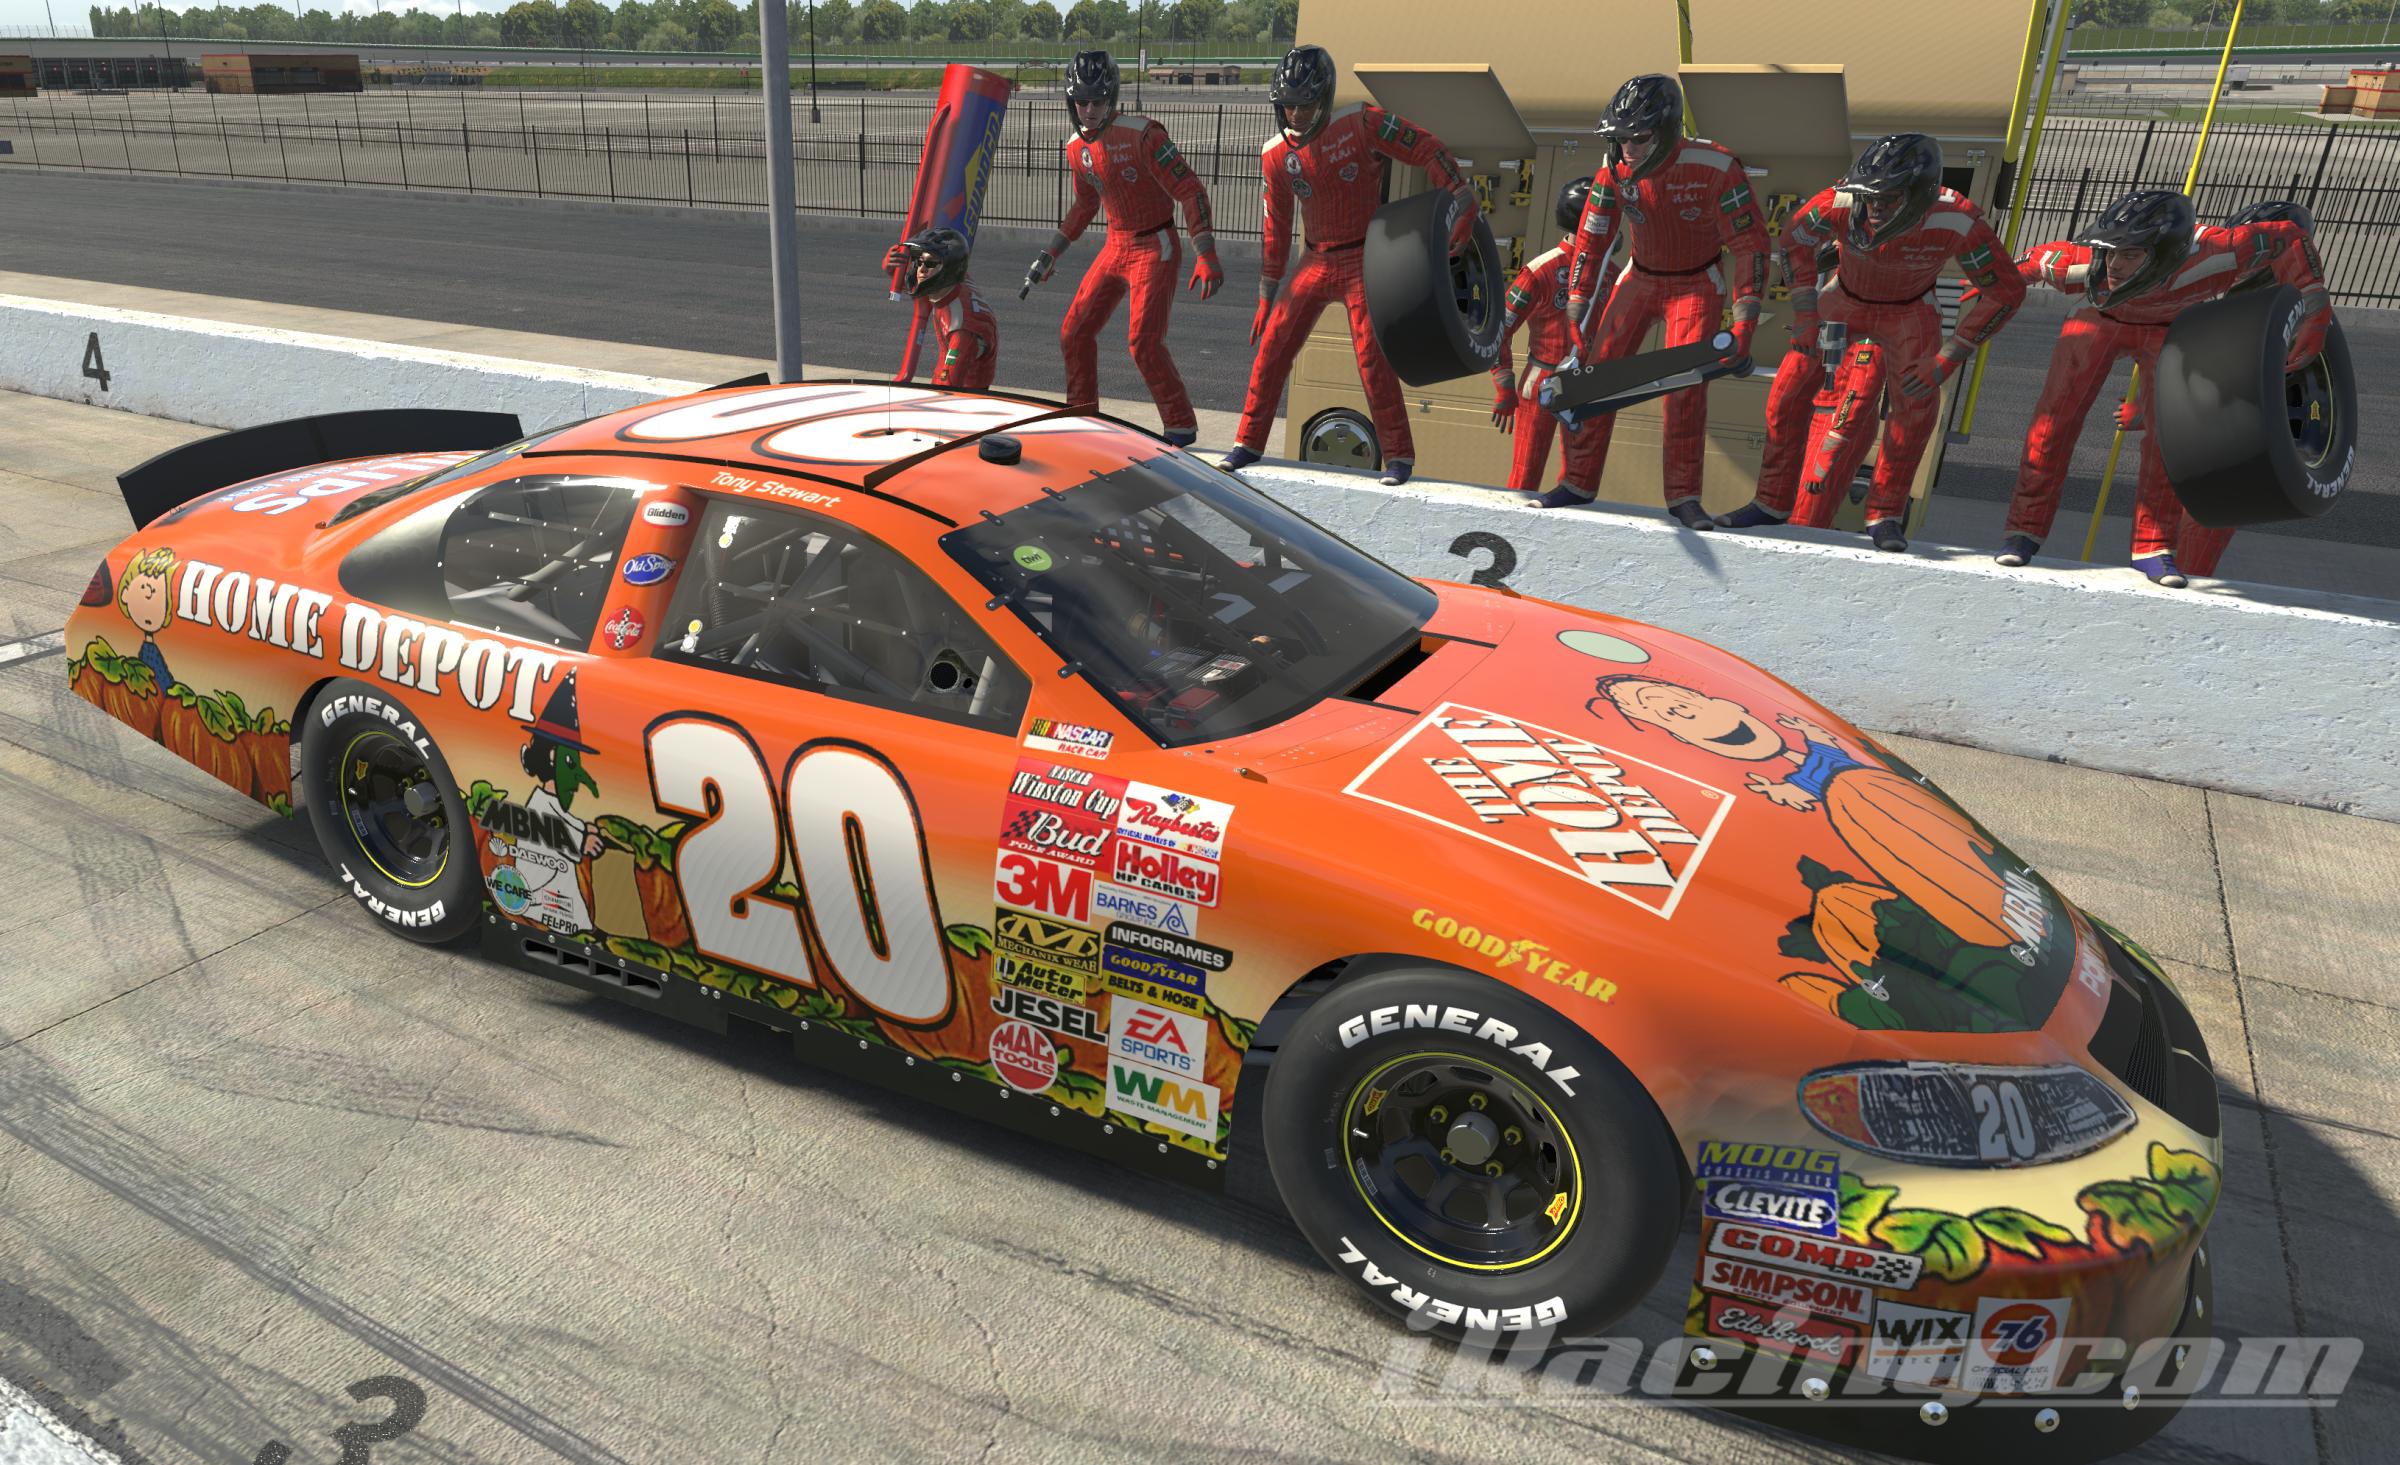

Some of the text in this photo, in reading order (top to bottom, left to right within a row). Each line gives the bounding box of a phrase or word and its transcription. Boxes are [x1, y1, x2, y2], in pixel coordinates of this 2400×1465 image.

[964, 111, 999, 237] SUNOCO
[81, 331, 111, 391] 4
[710, 471, 841, 508] Tony Stewart
[647, 507, 686, 521] Glidden
[623, 555, 677, 575] Old Spice
[176, 560, 561, 723] HOME DEPOT
[321, 695, 429, 759] GENERAL
[1053, 722, 1109, 748] NASCAR
[1058, 743, 1108, 759] RACE CAR
[1009, 771, 1121, 821] Winston Cup
[1047, 765, 1094, 786] NASCAR
[1422, 757, 1530, 825] THE
[1543, 736, 1702, 847] DEPOT
[1125, 796, 1220, 843] Raybestos
[1429, 714, 1679, 889] HOME
[479, 800, 582, 859] MBNA
[1027, 811, 1112, 857] Bud
[509, 845, 569, 873] DAEWOO
[642, 709, 958, 1033] 20
[1008, 840, 1096, 866] POLE AWARD
[1117, 842, 1217, 903] Holley
[341, 862, 447, 928] GENERAL
[486, 877, 533, 901] WE CARE
[996, 853, 1092, 923] 3M
[1096, 892, 1158, 920] BARNES
[1115, 871, 1137, 883] HP
[1141, 878, 1196, 900] CARBS
[997, 935, 1098, 972] MECHANIX WEAR
[1111, 925, 1225, 968] INFOGRAMES
[1411, 907, 1619, 1003] GOODYEAR
[1015, 974, 1084, 1000] Meter
[1020, 961, 1074, 986] Auto
[1110, 953, 1199, 986] GOODYEAR
[1108, 975, 1199, 1011] BELTS & HOSE
[992, 989, 1107, 1044] JESEL
[1124, 1008, 1189, 1055] EA
[993, 1023, 1056, 1065] MAC
[993, 1047, 1055, 1077] TOOLS
[1121, 1037, 1192, 1071] SPORTS
[1338, 1004, 1582, 1098] GENERAL
[1113, 1064, 1208, 1121] WM
[1116, 1095, 1207, 1129] WASTE MANAGEMENT
[1970, 1081, 2037, 1162] 20
[1701, 1141, 1841, 1174] MOOG
[1703, 1165, 1833, 1189] CHASSIS PARTS
[1714, 1182, 1829, 1224] CLEVITE
[1721, 1227, 1877, 1269] COMP
[1337, 1236, 1568, 1331] GENERAL
[1711, 1261, 1864, 1314] SIMPSON
[1716, 1306, 1843, 1357] Edelbrock
[1877, 1315, 1968, 1347] WIX
[1986, 1315, 2052, 1354] 76
[1872, 1354, 1962, 1366] FILTERS
